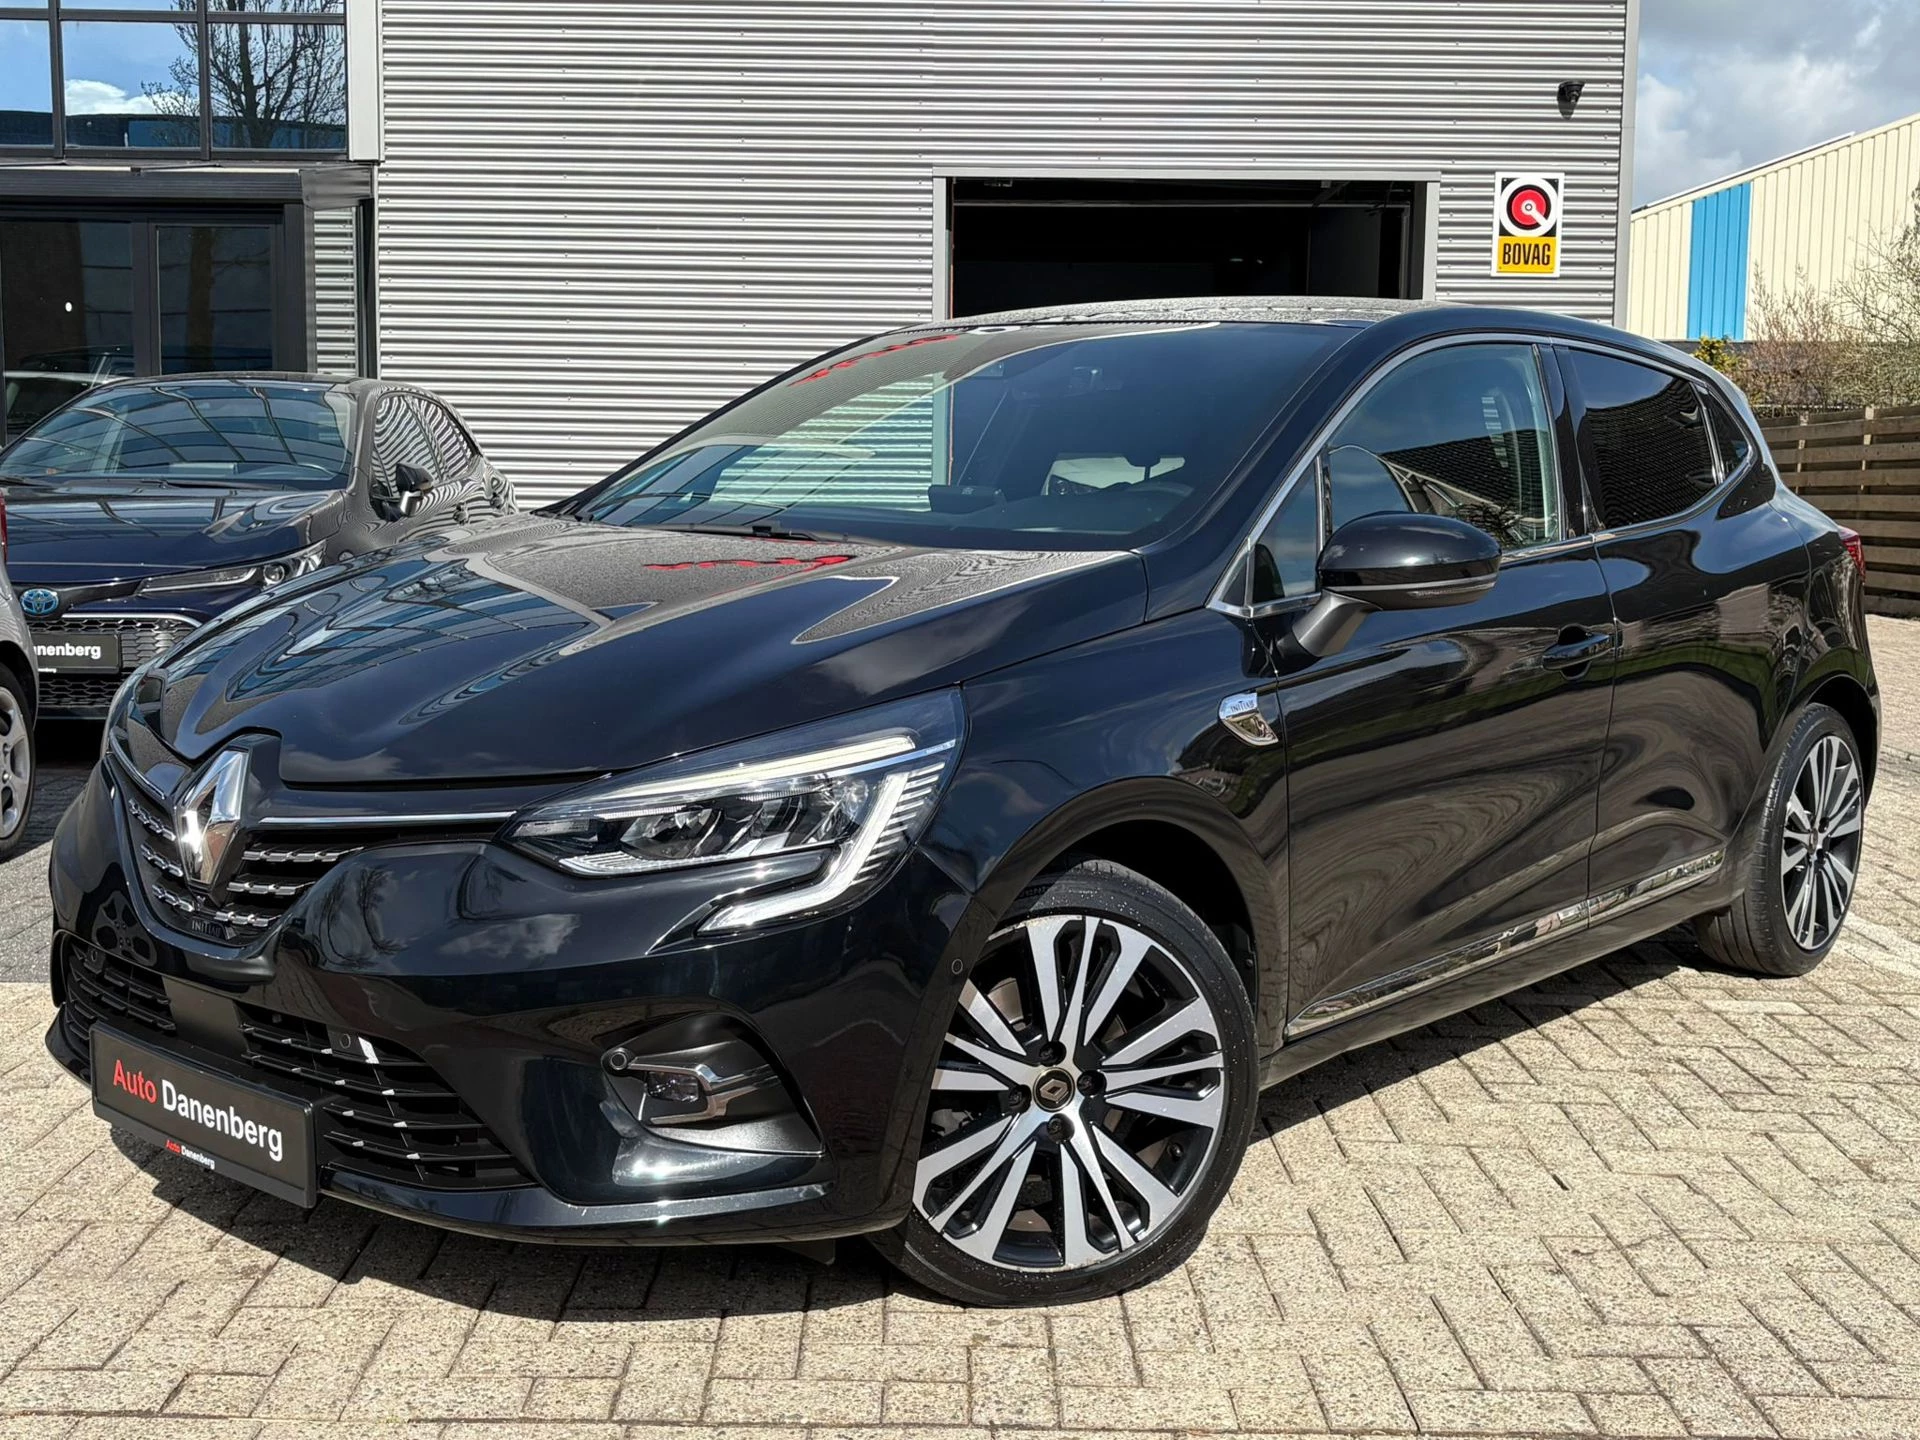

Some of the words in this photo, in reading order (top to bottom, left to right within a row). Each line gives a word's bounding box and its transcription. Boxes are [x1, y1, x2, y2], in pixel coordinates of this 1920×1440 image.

[1502, 242, 1551, 266] BOVAG
[33, 642, 101, 659] nenberg
[113, 1059, 157, 1103] Auto
[162, 1079, 283, 1162] Danenberg
